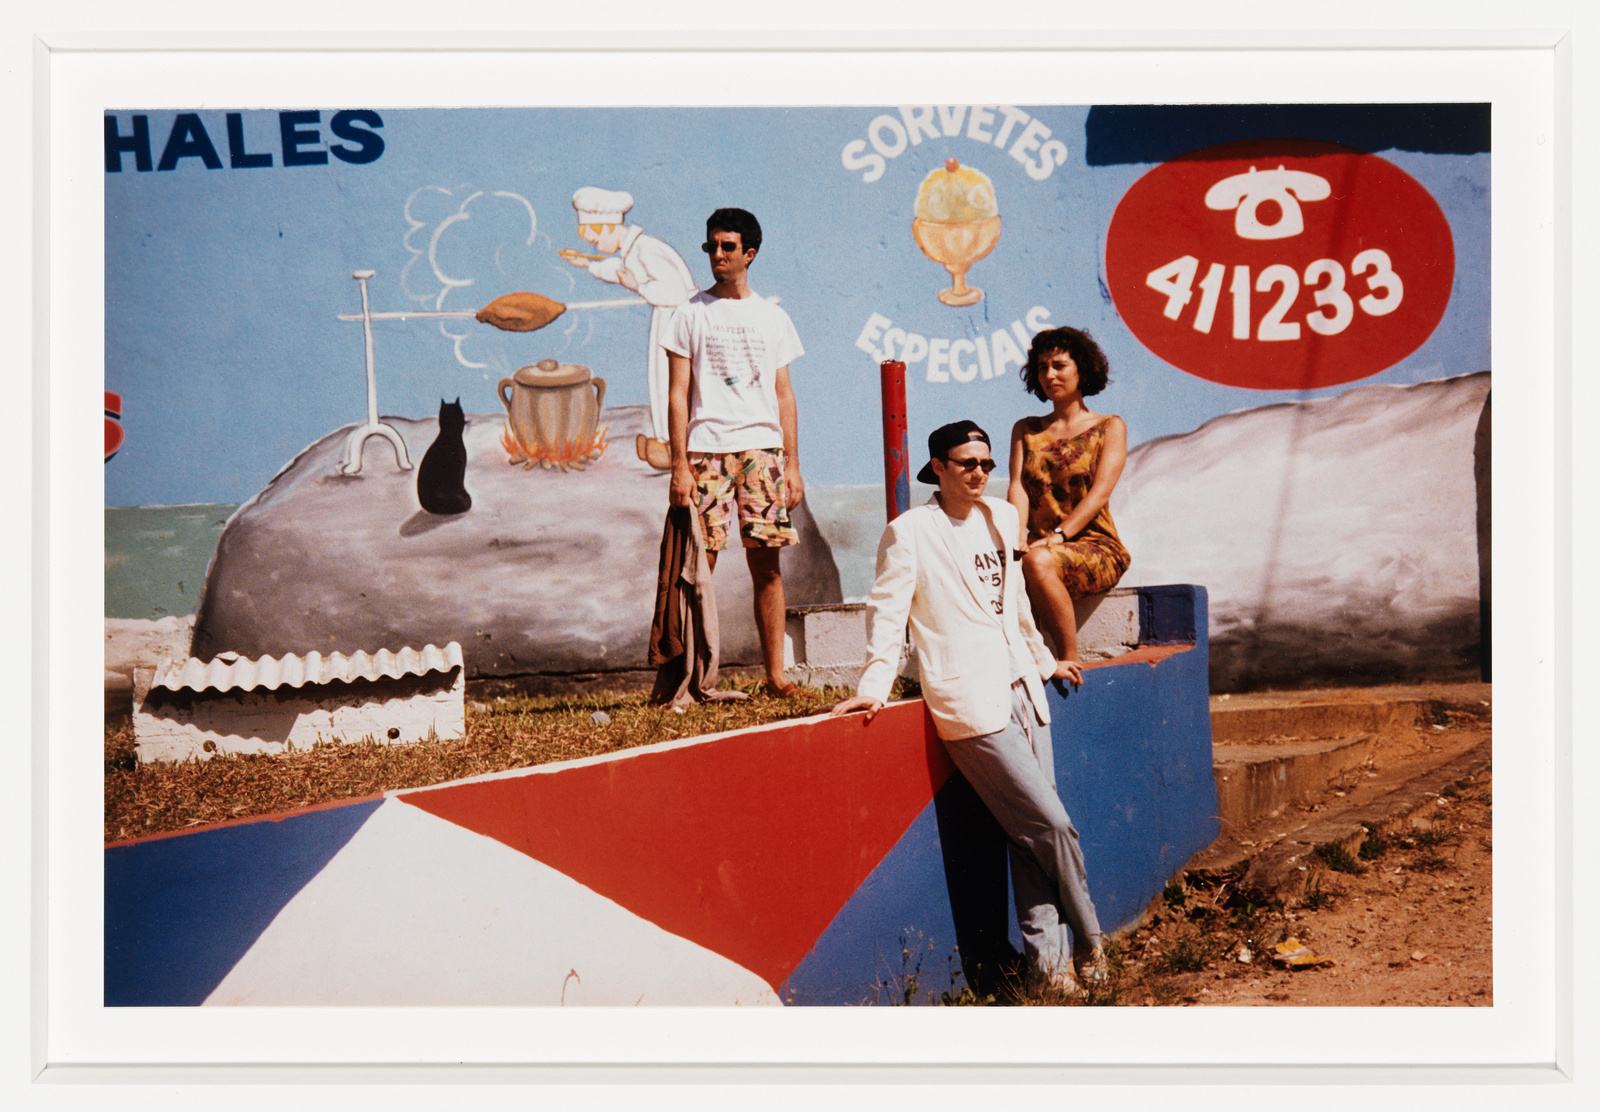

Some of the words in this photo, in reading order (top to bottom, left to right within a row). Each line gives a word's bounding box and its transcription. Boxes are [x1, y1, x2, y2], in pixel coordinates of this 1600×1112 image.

[104, 109, 386, 173] HALES
[841, 106, 1069, 183] SORVETES
[1145, 248, 1404, 342] 411233
[991, 572, 1001, 587] 5
